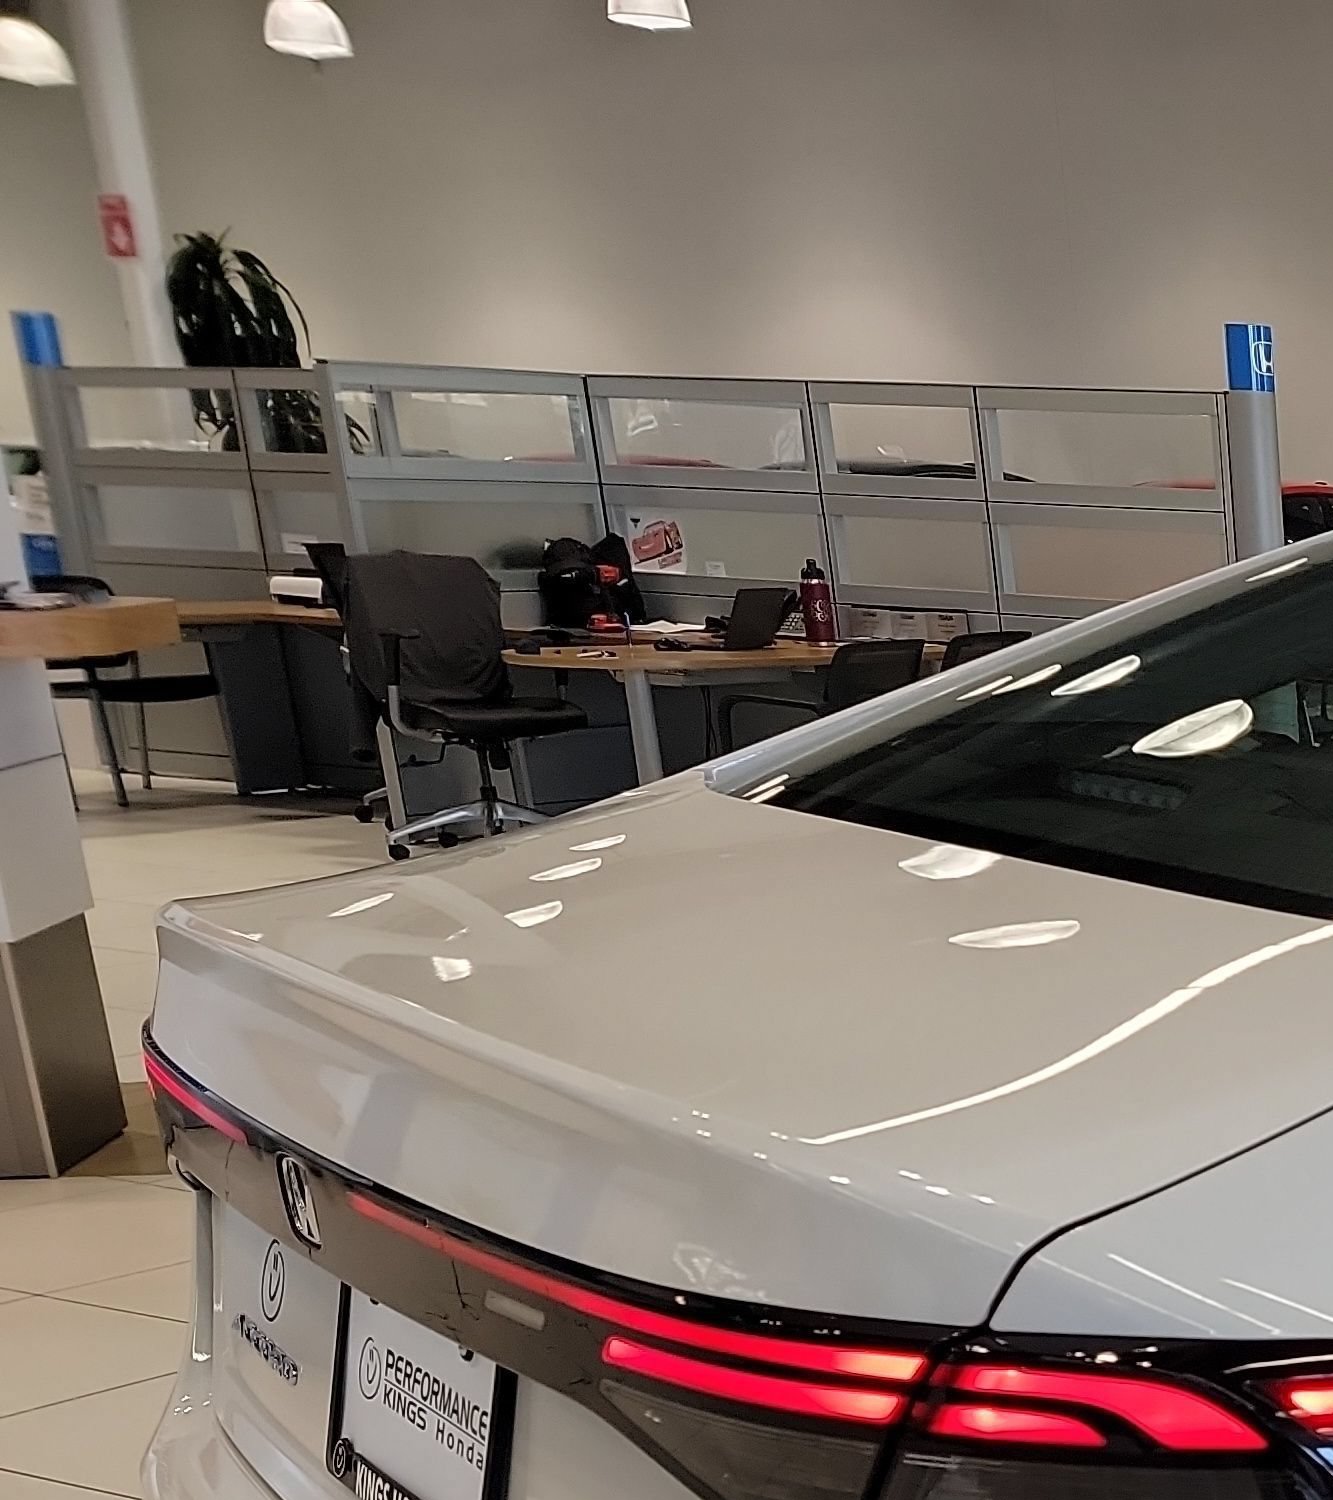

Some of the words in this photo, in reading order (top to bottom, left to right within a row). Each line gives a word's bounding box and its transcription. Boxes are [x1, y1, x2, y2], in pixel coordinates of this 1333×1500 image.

[383, 1383, 427, 1431] KINGS
[435, 1418, 484, 1471] Honda
[384, 1348, 489, 1441] PERFORMANCE
